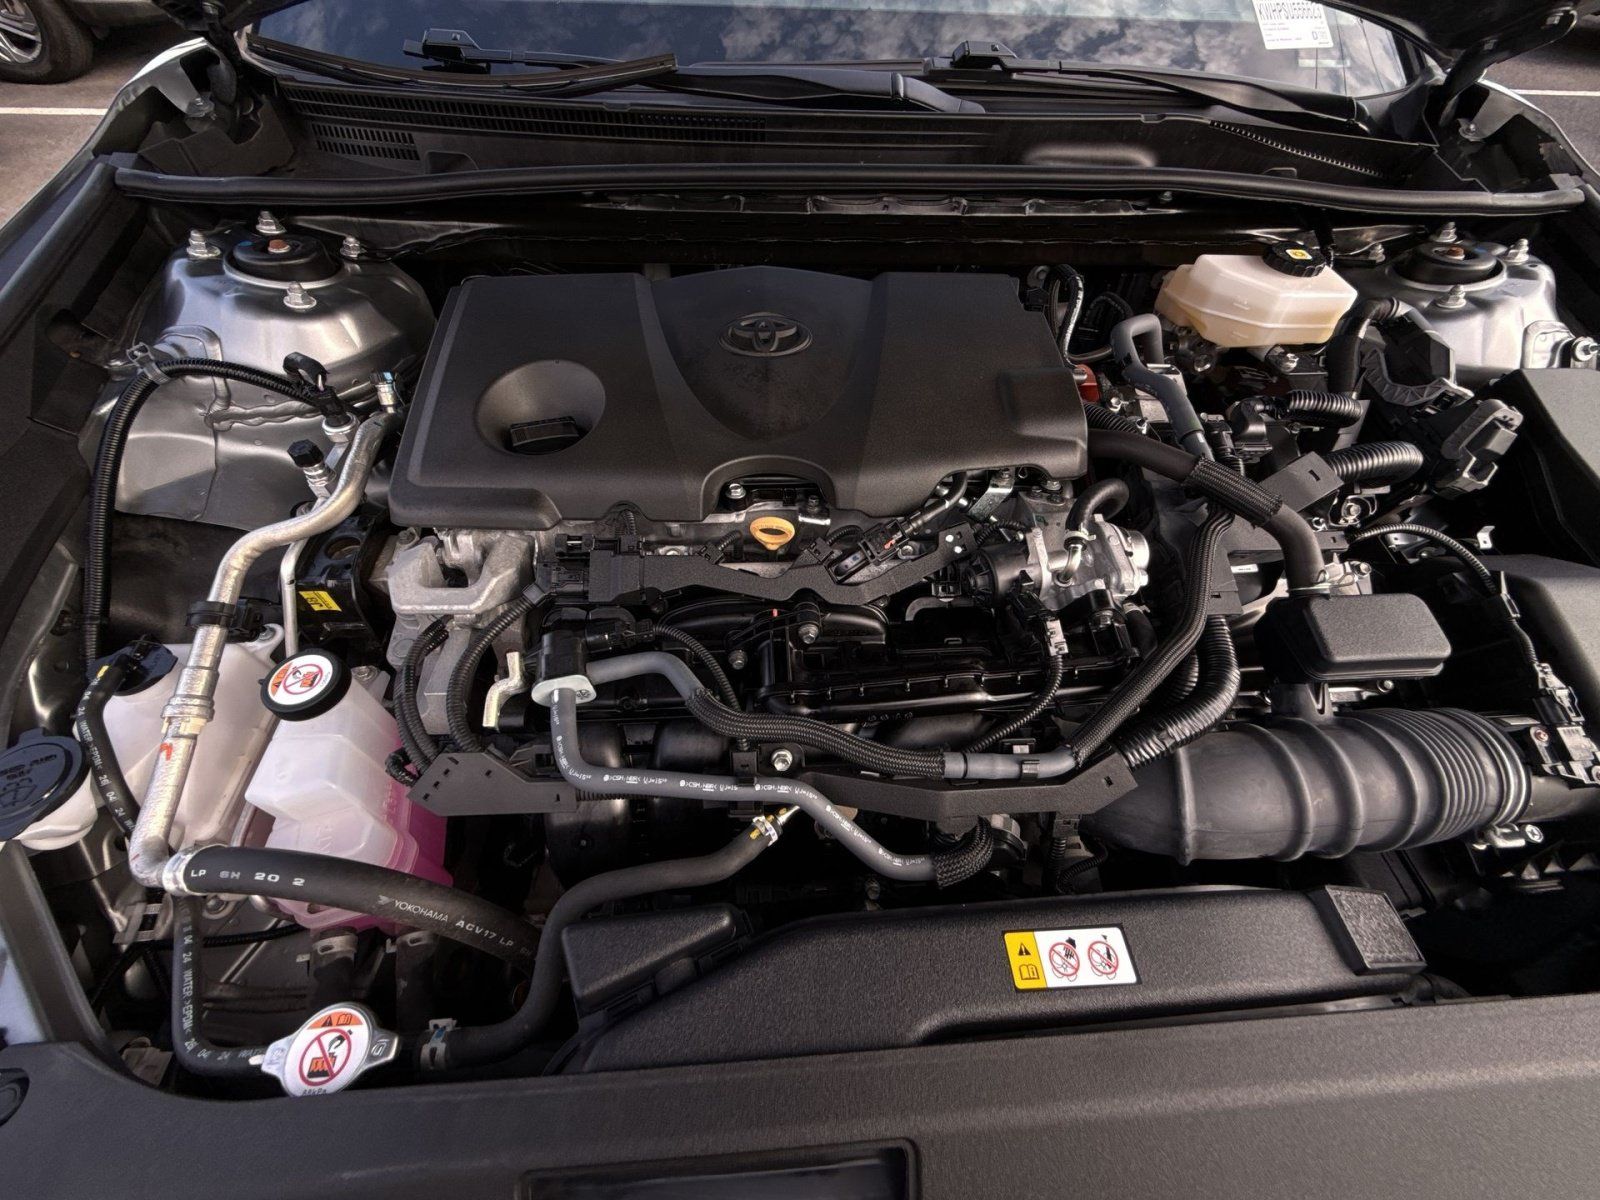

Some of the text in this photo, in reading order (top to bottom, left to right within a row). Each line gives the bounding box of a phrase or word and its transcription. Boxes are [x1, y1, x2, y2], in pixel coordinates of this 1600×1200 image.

[80, 721, 93, 745] WATER
[191, 869, 206, 877] LP
[254, 872, 279, 882] 20
[292, 878, 305, 886] 2
[393, 899, 448, 922] YOKOHAMA
[182, 952, 193, 964] 24
[183, 968, 194, 998] WATER
